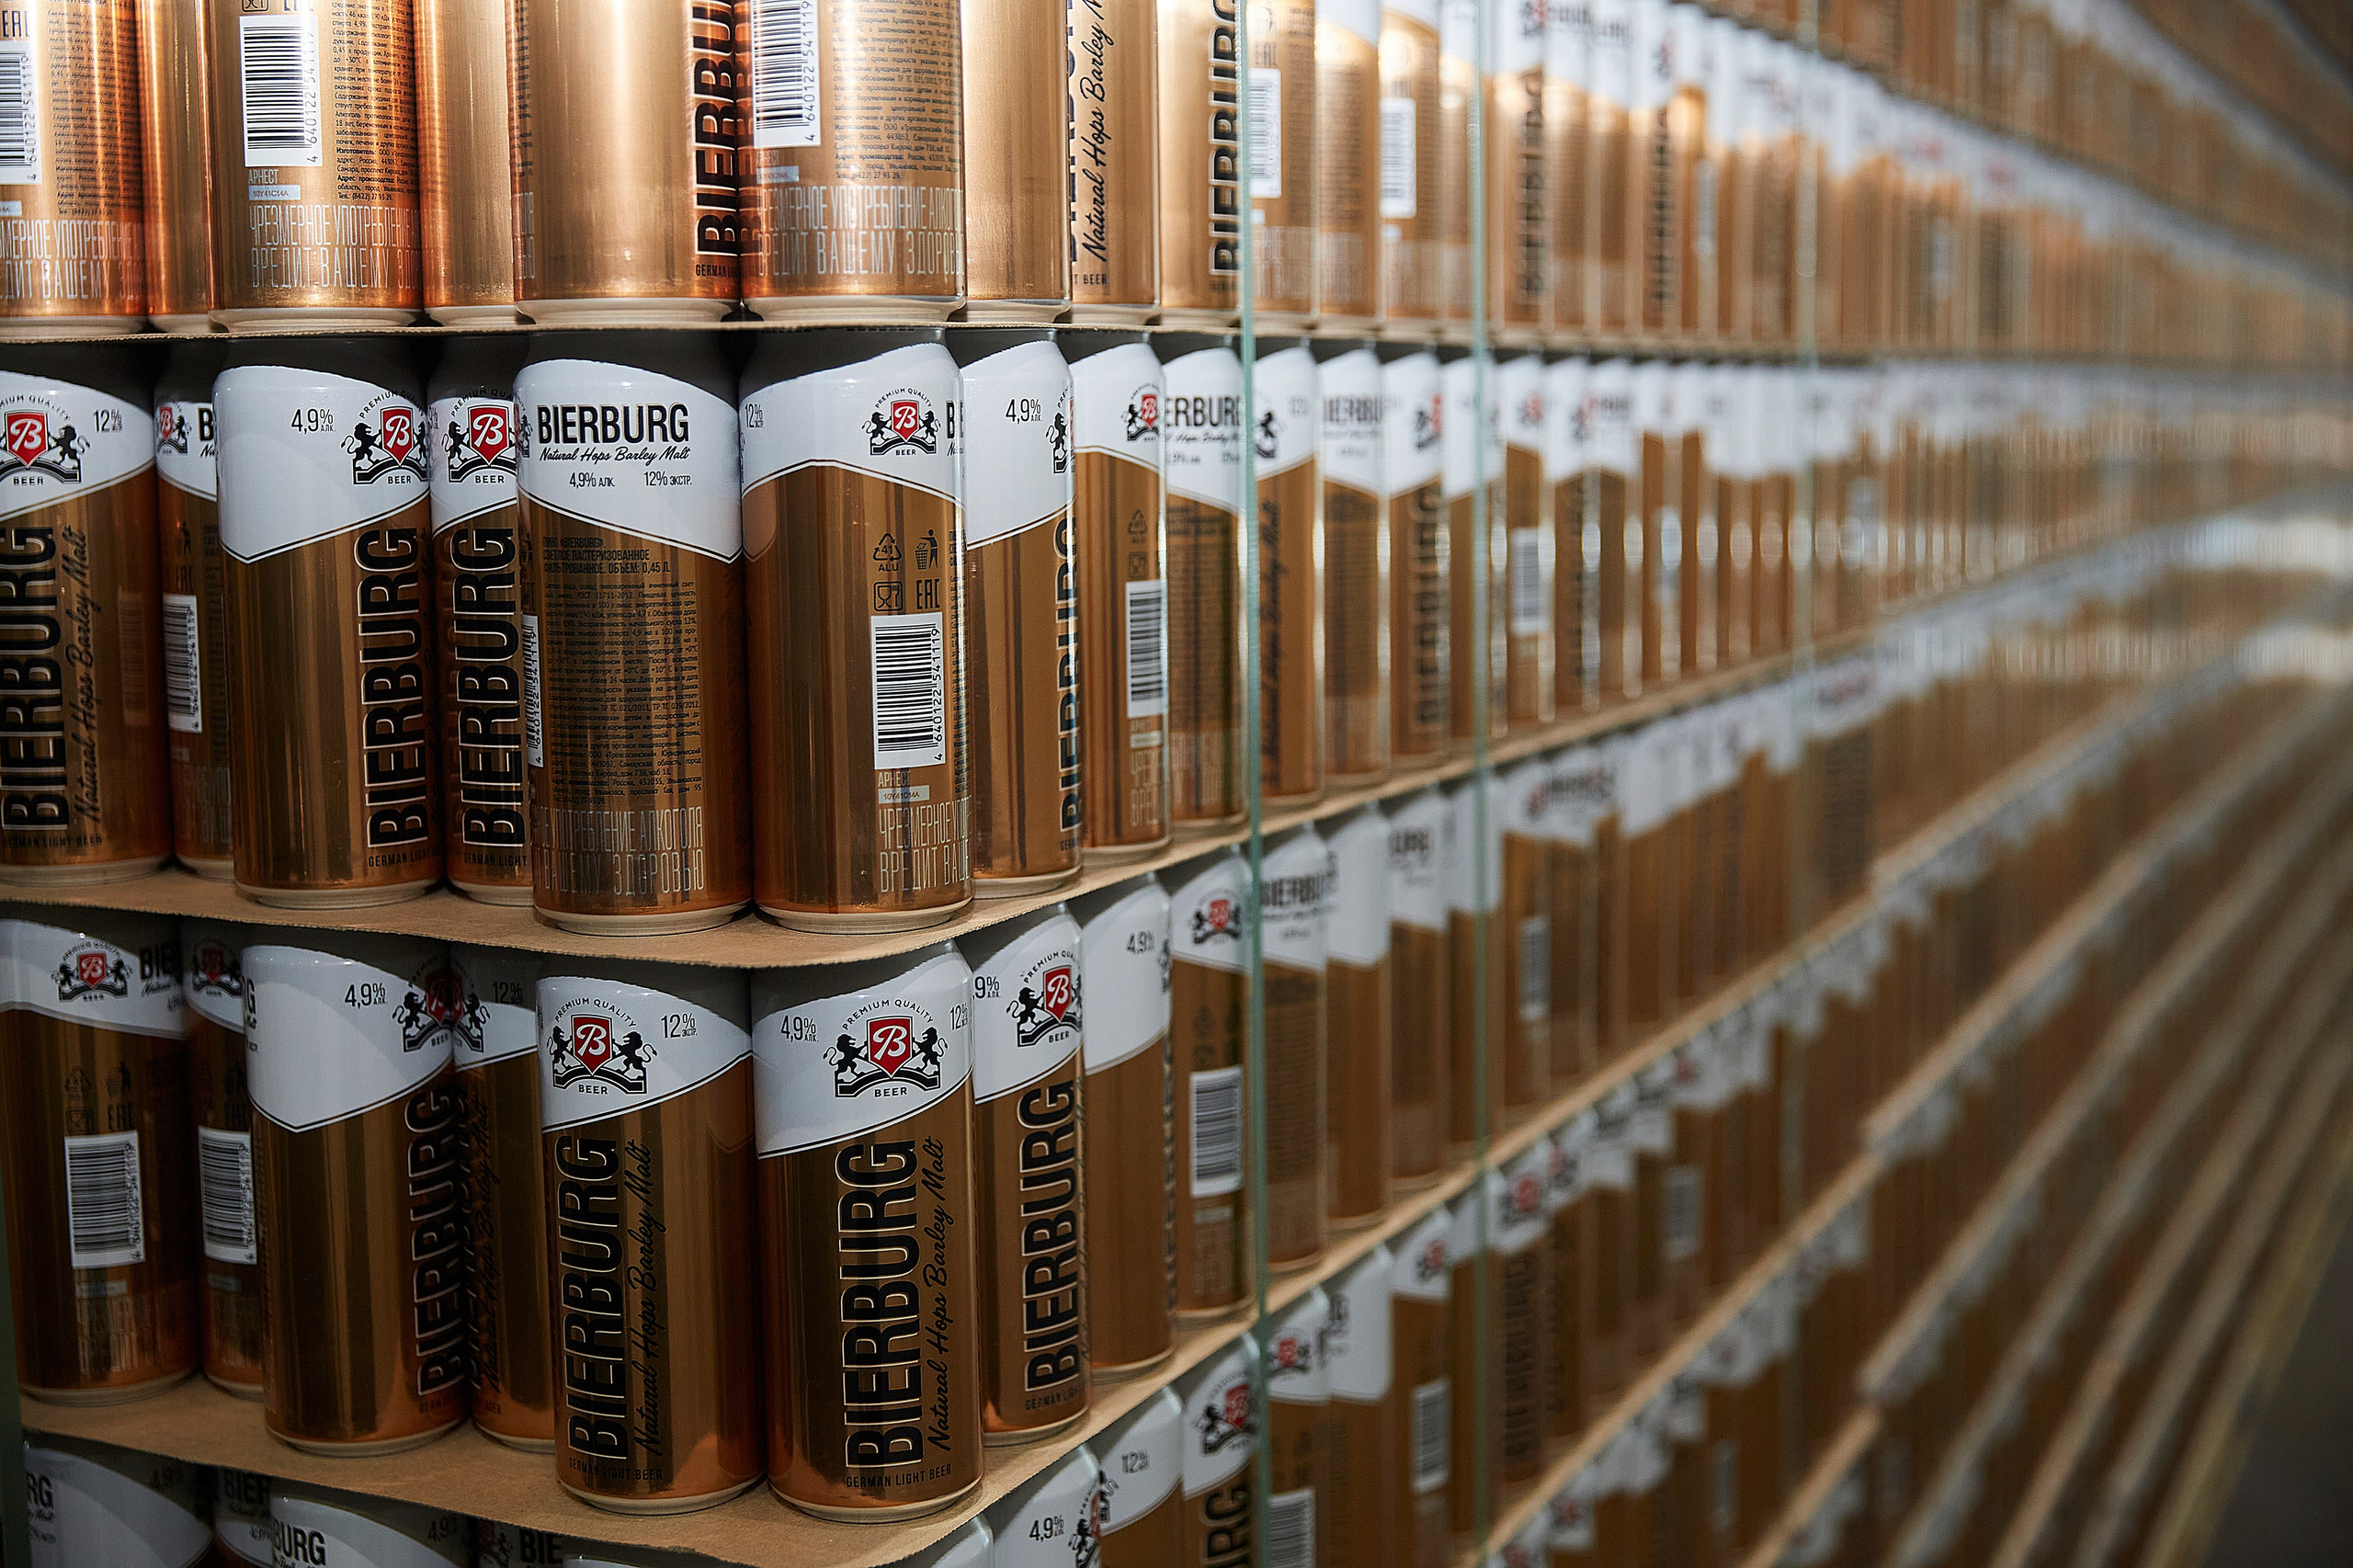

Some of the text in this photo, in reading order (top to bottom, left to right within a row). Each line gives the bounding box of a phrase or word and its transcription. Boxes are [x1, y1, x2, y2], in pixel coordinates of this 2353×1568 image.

[801, 1, 816, 142] 4 640122 541119
[305, 91, 318, 143] 640122
[692, 0, 738, 256] BIERBU
[1079, 20, 1115, 262] Natural Hops Barley
[248, 169, 278, 184] АРНЕСТ
[830, 186, 926, 230] УПОТРЕБЛЕНИЕ
[250, 205, 330, 247] ЧРЕЗМЕРНОЕ
[251, 247, 389, 289] ВРЕДИТ ВАШЕМУ
[817, 231, 895, 275] ВАШЕМУ
[41, 259, 109, 299] ВАШЕМУ
[28, 394, 71, 421] QUALITY
[359, 390, 399, 419] PREMIUM
[450, 388, 488, 418] PREMIUM
[875, 387, 933, 408] PREMIUM QUALITY
[1005, 398, 1041, 425] 4,9%
[1165, 395, 1240, 427] ERBUR
[290, 408, 334, 435] 4,9%
[472, 414, 504, 448] B
[537, 402, 689, 444] BIERBURG
[745, 403, 763, 428] 12%
[894, 405, 916, 429] B
[385, 415, 410, 449] B
[540, 446, 691, 466] Natural Hops Barley Malt
[895, 448, 916, 457] BEER
[13, 476, 44, 485] BEER
[388, 476, 412, 485] BEER
[475, 475, 505, 484] BEER
[569, 472, 597, 490] 4,9%
[643, 471, 668, 487] 12%
[669, 475, 692, 486] ЭКСТР.
[572, 549, 650, 561] ПАСТЕРИЗОВАННОЕ
[881, 546, 893, 555] 41
[608, 562, 641, 574] ОБЪЕМ:
[642, 561, 661, 574] 0,45
[878, 562, 900, 572] ALU
[916, 578, 941, 610] EAC
[0, 527, 70, 830] BIERBURG
[354, 528, 428, 848] BIERBURG
[449, 528, 526, 847] BIERBURG
[930, 628, 943, 762] 4 640122 541119
[532, 691, 541, 745] 640122
[878, 770, 911, 788] АРНЕСТ
[639, 806, 704, 851] АЛКОГОЛЯ
[879, 801, 950, 849] ЧРЕЗМЕРНОЕ
[369, 853, 407, 868] GERMAN
[499, 855, 527, 868] LIGHT
[612, 848, 704, 897] ЗДОРОВЬЮ
[880, 846, 938, 893] ВРЕДИТ
[1023, 950, 1059, 983] PREMIUM
[345, 983, 385, 1009] 4,9%
[973, 975, 1000, 999] ,9%
[1047, 973, 1069, 1009] B
[554, 997, 637, 1028] PREMIUM QUALITY
[660, 1013, 696, 1040] 12%
[842, 998, 934, 1030] PREMIUM QUALITY
[575, 1023, 607, 1057] B
[780, 1015, 816, 1043] 4,9%
[872, 1025, 907, 1061] B
[1049, 1029, 1070, 1043] BEER
[578, 1085, 608, 1095] BEER
[874, 1086, 908, 1098] BEER
[1017, 1079, 1081, 1392] BIERBURG
[554, 1133, 629, 1460] BIERBURG
[623, 1138, 667, 1457] Natural Hops Barley Malt
[835, 1139, 925, 1469] BIERBURG
[920, 1134, 955, 1452] Natural Hops Barley Malt
[602, 1463, 631, 1482] LIGHT
[634, 1466, 664, 1482] BEER
[846, 1463, 952, 1489] GERMAN LIGHT BEER
[273, 1519, 326, 1566] BURG
